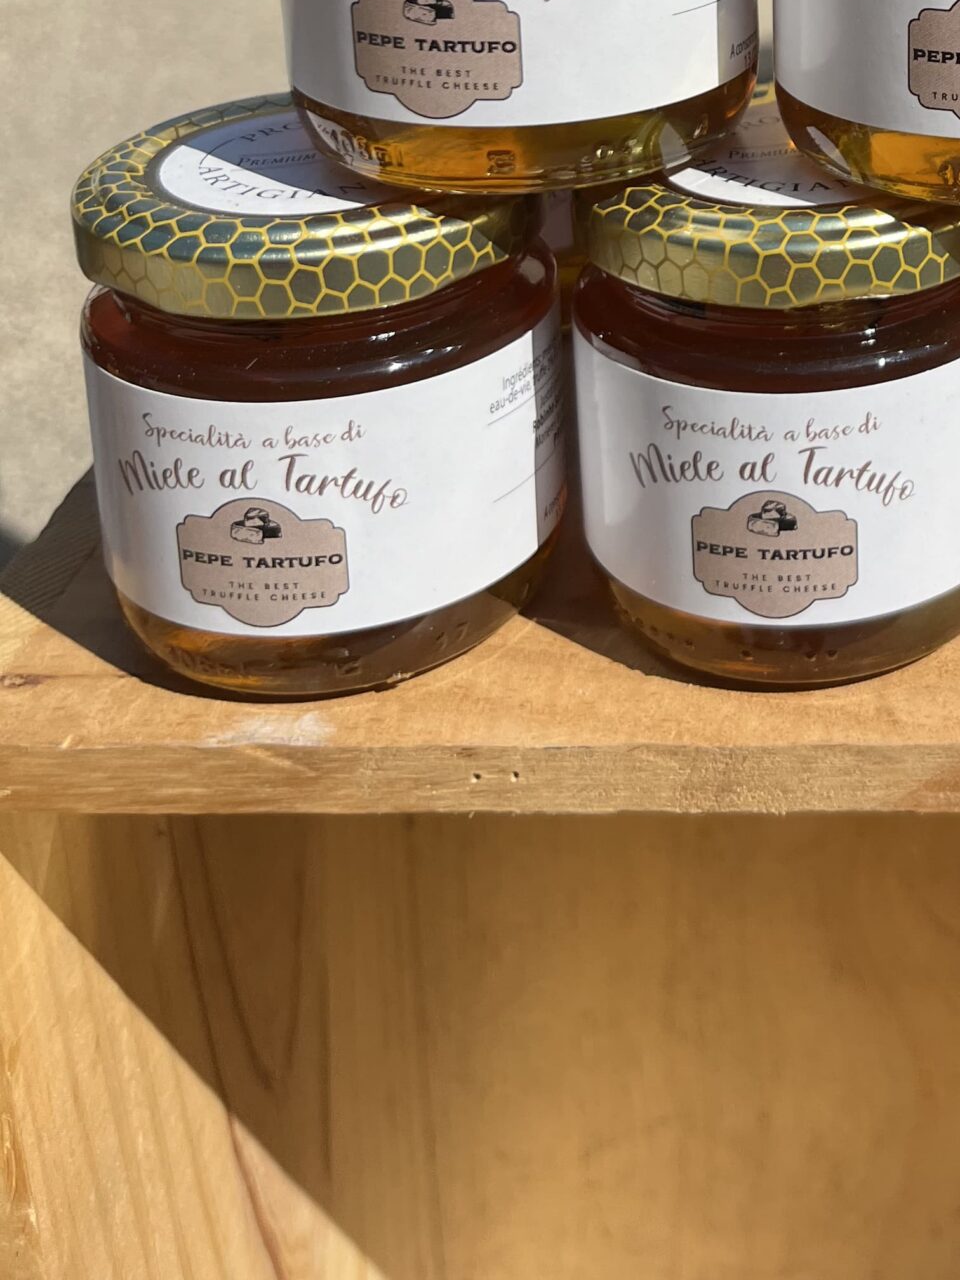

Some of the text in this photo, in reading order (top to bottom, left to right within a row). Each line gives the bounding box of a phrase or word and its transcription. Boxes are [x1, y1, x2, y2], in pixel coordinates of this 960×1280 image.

[357, 31, 516, 54] PEPE TARTUFO
[401, 66, 472, 79] THE BEST
[375, 75, 500, 91] TRUFFLE CHEESE
[199, 165, 367, 200] ARTIGIAN
[143, 412, 365, 450] Specialità a base di
[661, 406, 881, 442] Specialità a base di
[119, 450, 410, 514] Miele al Tartufo
[629, 443, 916, 506] Miele al Tartufo
[182, 548, 343, 568] PEPE TARTUFO
[696, 541, 854, 560] PEPE TARTUFO
[228, 581, 299, 590] THE BEST
[715, 580, 837, 593] TRUFFLE CHEESE
[743, 573, 811, 582] THE BEST
[202, 588, 327, 601] TRUFFLE CHEESE
